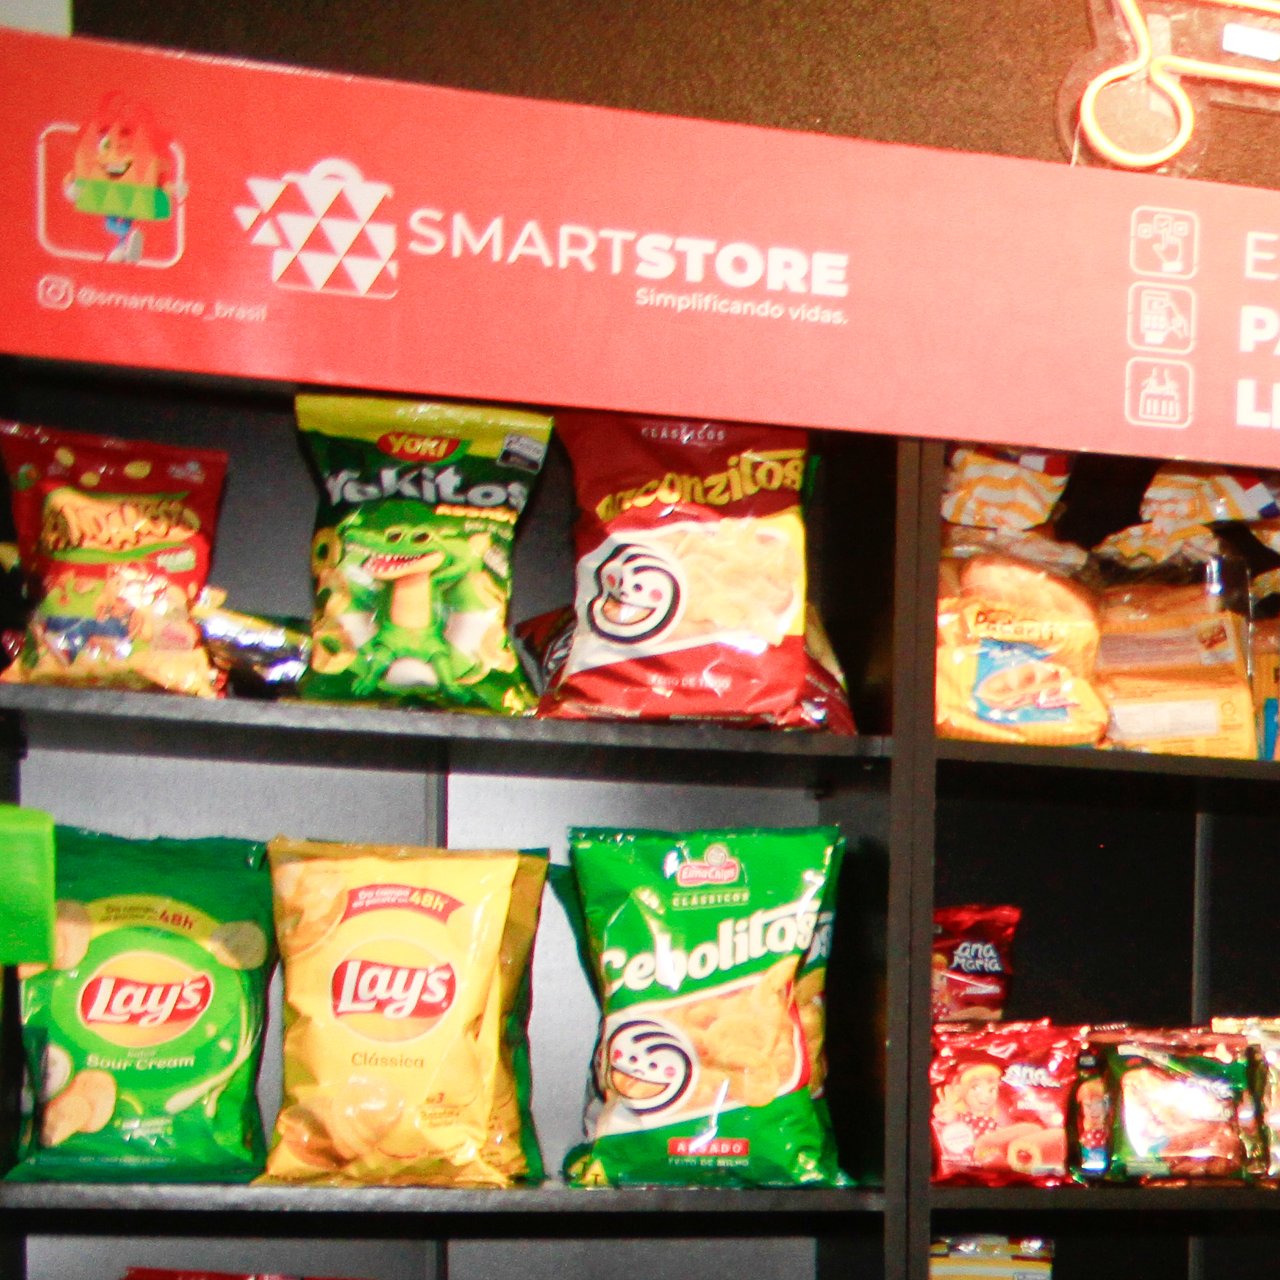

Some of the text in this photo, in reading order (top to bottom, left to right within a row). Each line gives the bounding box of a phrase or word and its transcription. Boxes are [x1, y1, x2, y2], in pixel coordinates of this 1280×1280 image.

[408, 209, 850, 297] SMARTSTORE
[76, 284, 269, 323] @smartstore_brasil
[635, 286, 849, 327] Simplificando vidas.
[86, 970, 206, 1028] Lay's
[337, 959, 450, 1019] Lay's
[86, 1053, 196, 1071] Sour Cream
[350, 1052, 425, 1070] Clássica
